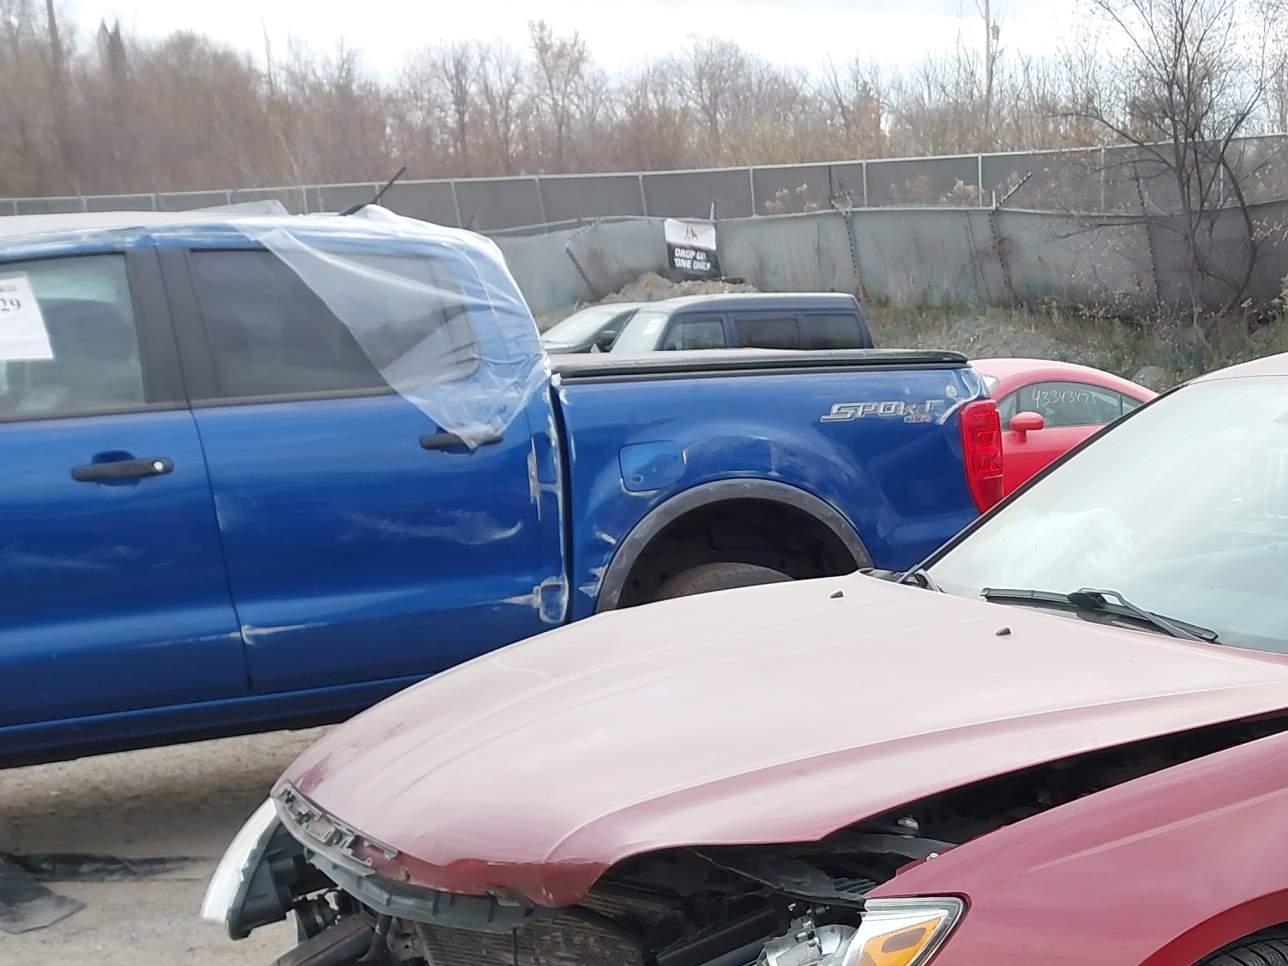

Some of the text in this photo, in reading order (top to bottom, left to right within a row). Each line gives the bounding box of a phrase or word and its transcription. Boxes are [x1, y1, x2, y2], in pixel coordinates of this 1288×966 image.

[675, 248, 695, 258] DROP
[693, 260, 711, 270] ONLY
[819, 399, 945, 424] SPORT
